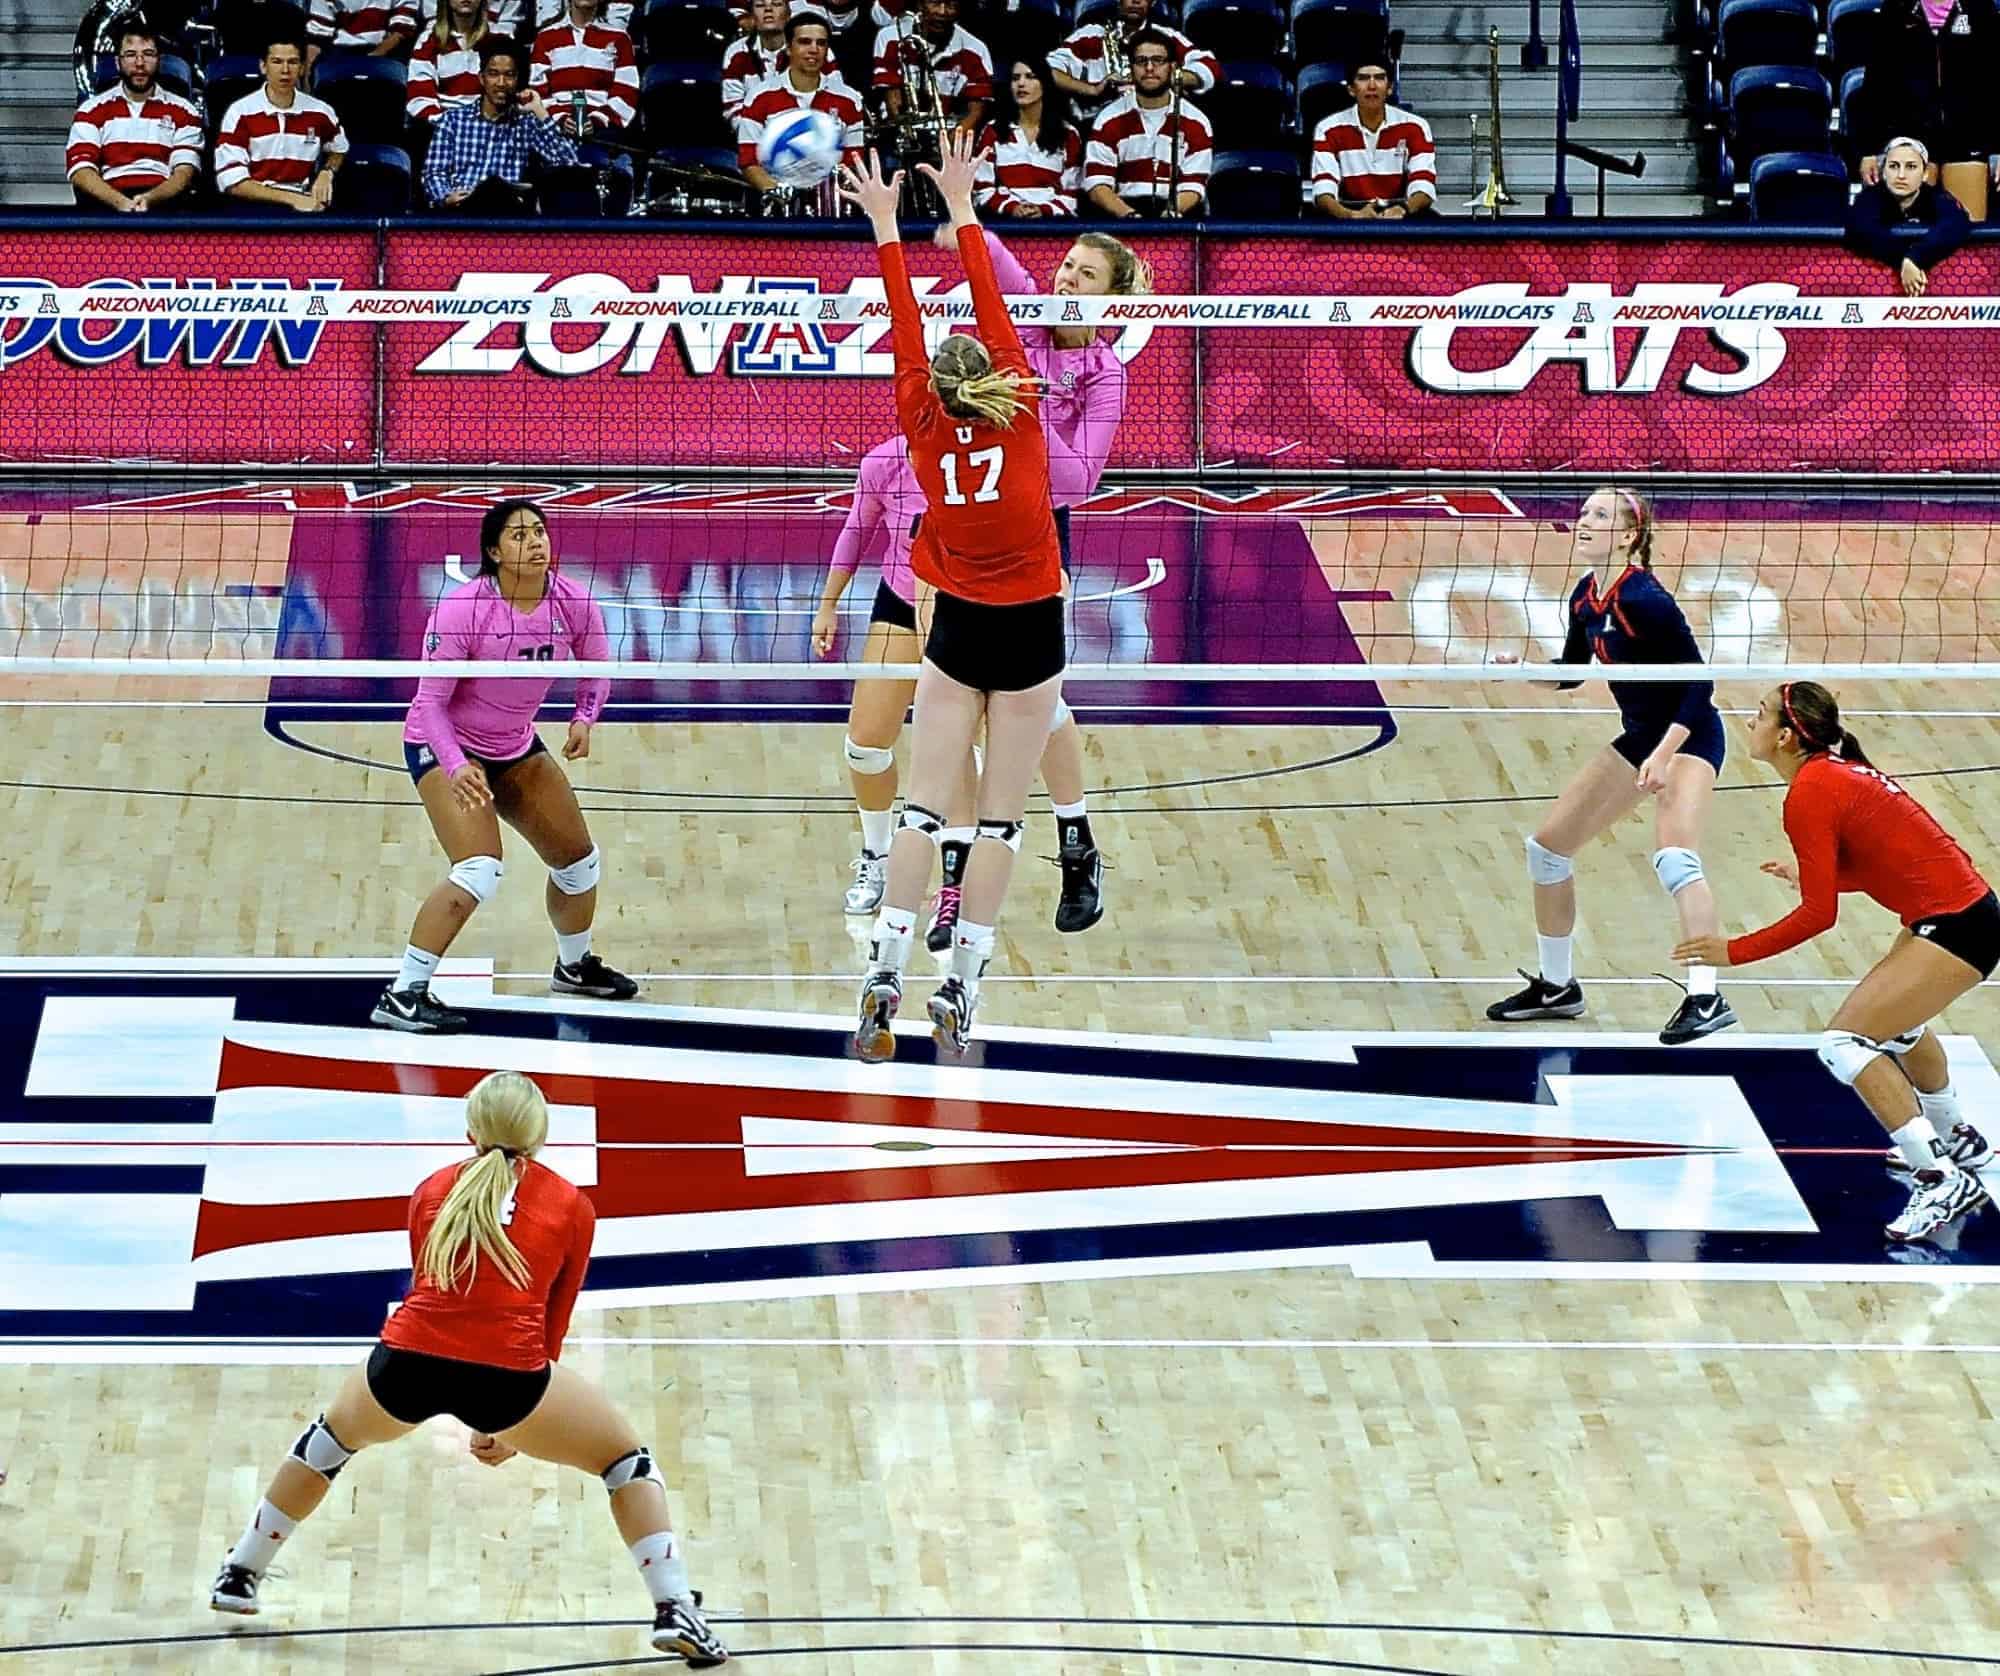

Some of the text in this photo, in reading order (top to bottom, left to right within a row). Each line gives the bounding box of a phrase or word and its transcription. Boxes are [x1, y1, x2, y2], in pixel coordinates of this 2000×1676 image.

[80, 297, 289, 313] ARIZONAVOLLEYBALL
[348, 299, 532, 315] ARIZONAWILDCATS
[591, 301, 800, 317] ARIZONAVOLLEYBALL
[1102, 303, 1311, 319] ARIZONAVOLLEYBALL
[1370, 304, 1554, 320] ARIZONAWILDCATS
[1614, 305, 1824, 321] ARIZONAVOLLEYBALL
[1412, 281, 1800, 393] CATS
[939, 445, 1004, 505] 17
